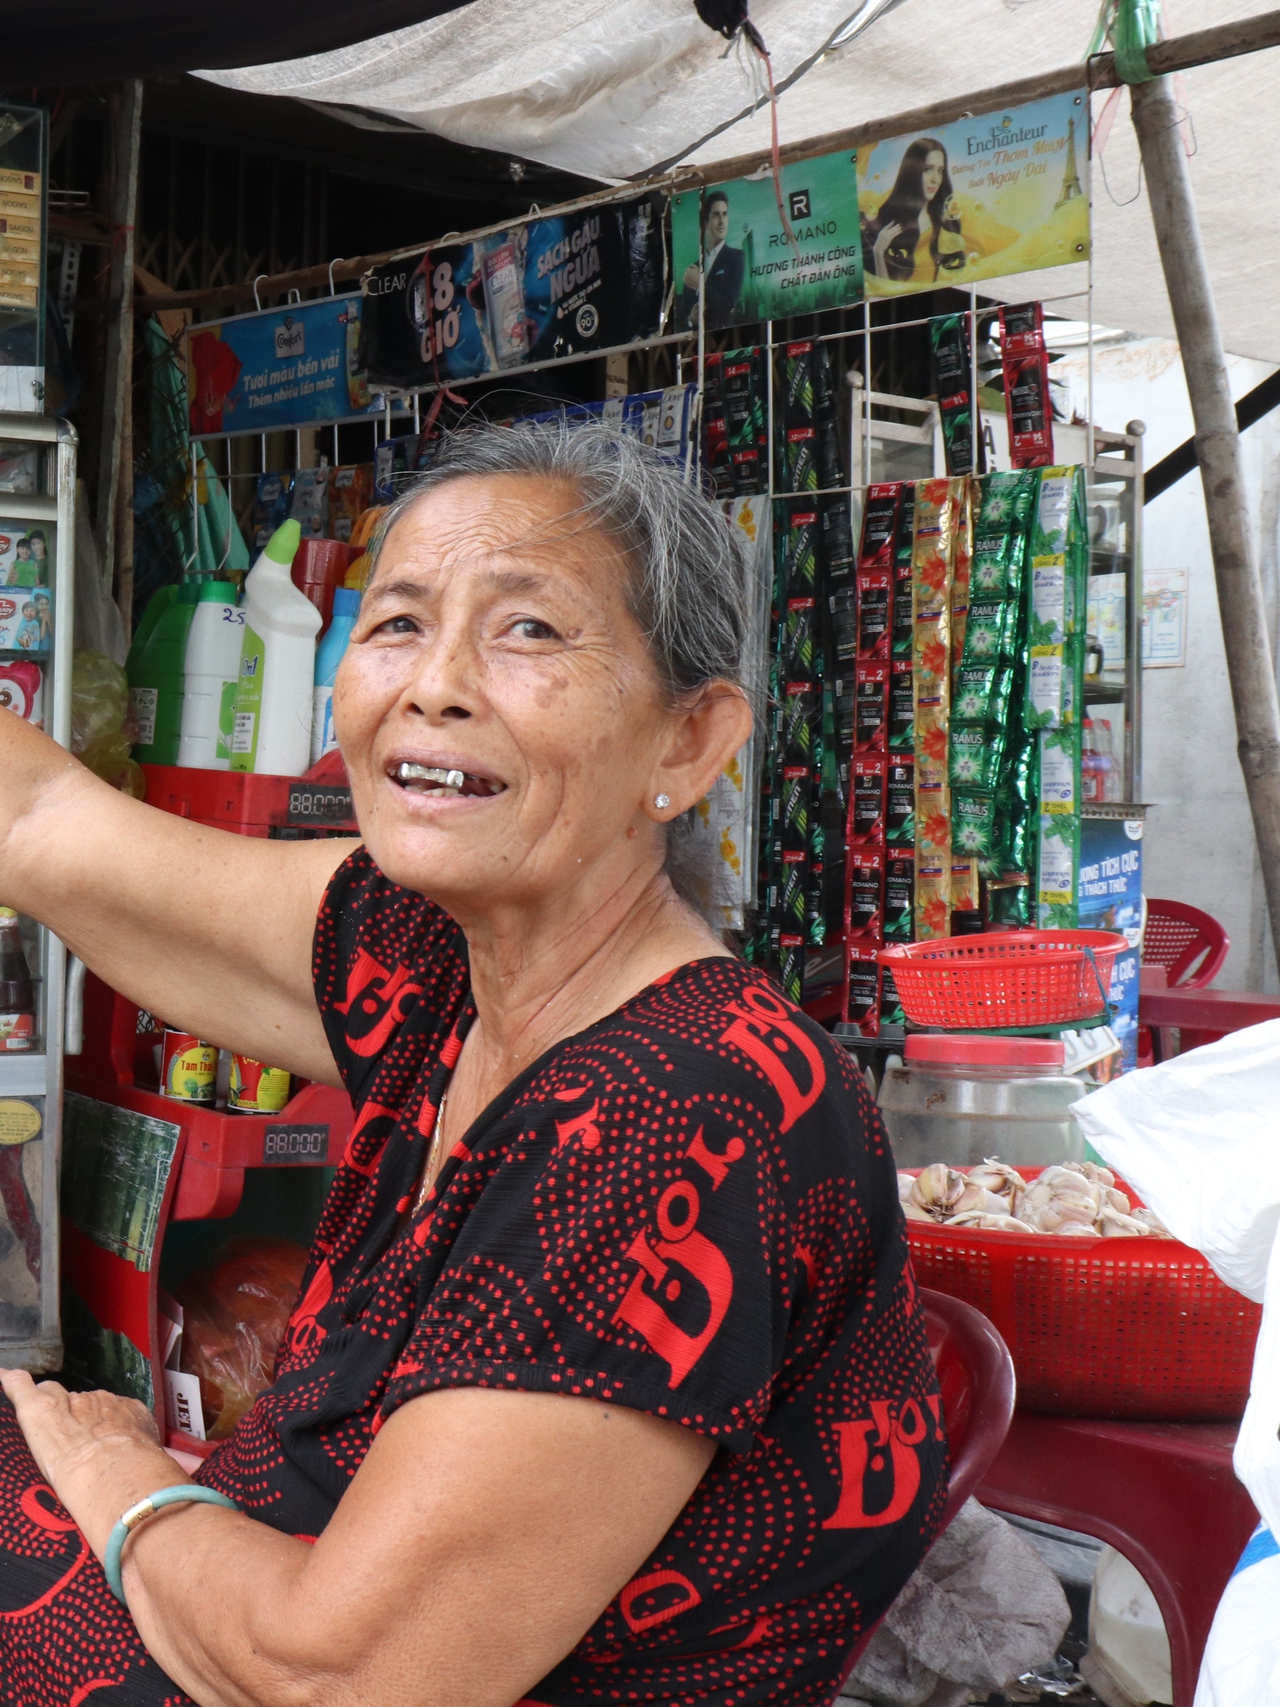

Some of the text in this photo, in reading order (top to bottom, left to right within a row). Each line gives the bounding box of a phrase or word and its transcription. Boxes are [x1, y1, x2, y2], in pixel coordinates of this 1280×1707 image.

[967, 124, 1048, 156] Enchanteur
[793, 195, 808, 216] R
[8, 224, 34, 234] SAIGON
[769, 221, 837, 248] ROMANO
[537, 237, 570, 278] SẠCH
[751, 245, 856, 278] HƯƠNG THÀNH CÔNG
[781, 264, 856, 289] CHẤT ĐÀN ÔNG
[368, 272, 407, 296] CLEAR
[277, 331, 303, 349] Comfort
[1062, 467, 1068, 477] 2
[888, 487, 896, 496] 2
[976, 541, 1004, 551] RAMUS
[1052, 556, 1060, 565] 2
[881, 576, 888, 586] 2
[223, 608, 245, 624] 25
[972, 606, 1001, 617] RAMUS
[1051, 646, 1058, 656] 2
[876, 670, 883, 681] 2
[953, 733, 983, 744] RAMUS
[874, 764, 881, 774] 2
[958, 803, 989, 815] RAMUS
[872, 857, 880, 867] 2
[1101, 856, 1119, 878] TÍCH
[1122, 850, 1139, 877] CỰC
[1084, 876, 1128, 897] THÁCH THỨC
[1119, 957, 1136, 985] CỰC
[850, 974, 876, 982] ROMANO
[182, 1060, 197, 1071] Tam
[176, 1392, 192, 1434] JET
